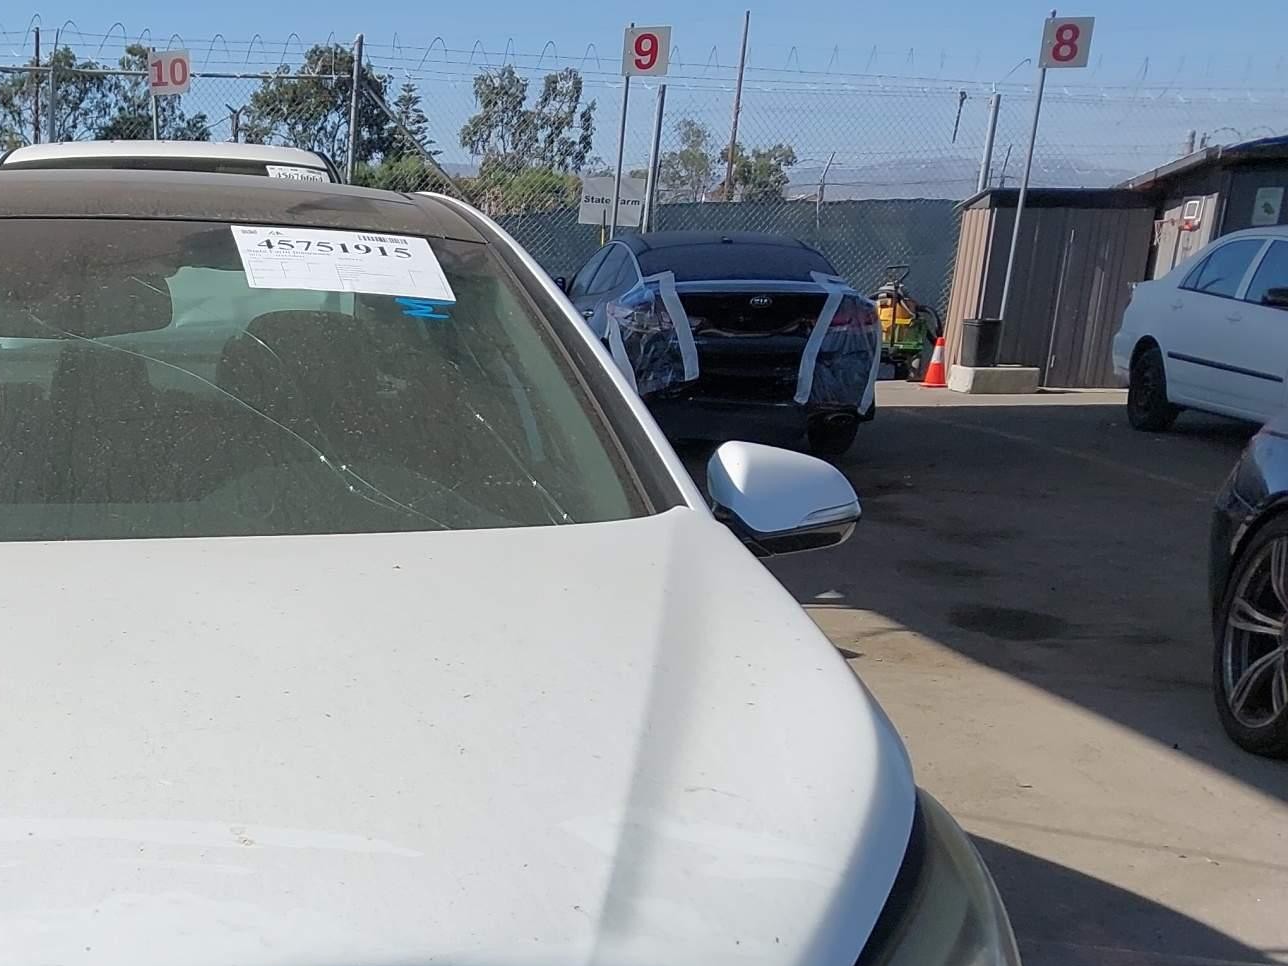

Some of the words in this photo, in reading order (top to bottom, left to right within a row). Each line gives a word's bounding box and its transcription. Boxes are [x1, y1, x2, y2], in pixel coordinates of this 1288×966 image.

[634, 32, 659, 71] 9
[1051, 23, 1080, 62] 8
[151, 58, 188, 87] 10
[584, 195, 611, 204] State
[617, 197, 640, 206] arm
[257, 238, 413, 259] 45751915
